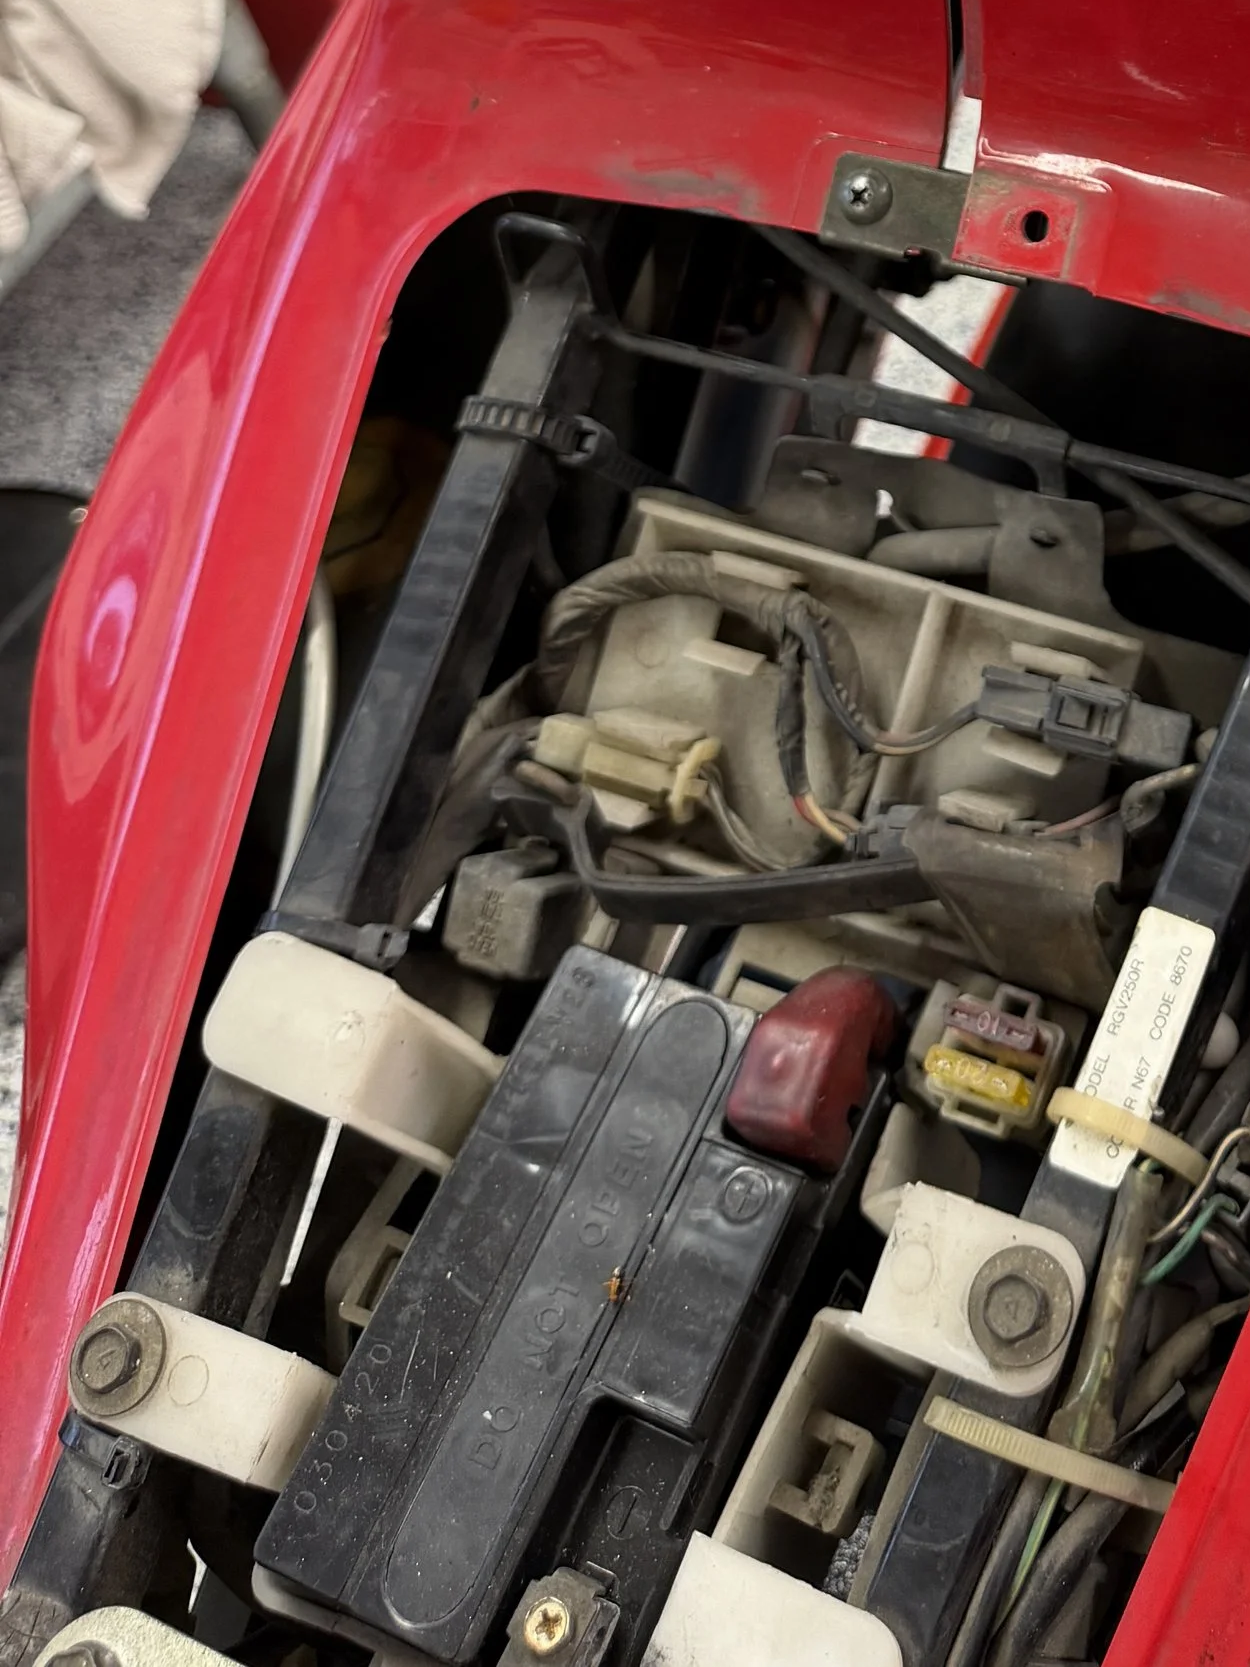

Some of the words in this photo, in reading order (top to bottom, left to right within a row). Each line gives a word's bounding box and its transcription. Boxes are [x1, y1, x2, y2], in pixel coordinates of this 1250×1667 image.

[1106, 1097, 1138, 1159] COR
[1131, 1057, 1152, 1091] N67
[1149, 992, 1176, 1041] CODE
[1169, 945, 1192, 986] 8670
[1107, 958, 1144, 1036] RGV250R
[470, 1405, 521, 1471] DO
[518, 1277, 579, 1372] NOT
[578, 1131, 653, 1248] OPEN
[294, 1344, 392, 1514] 030420
